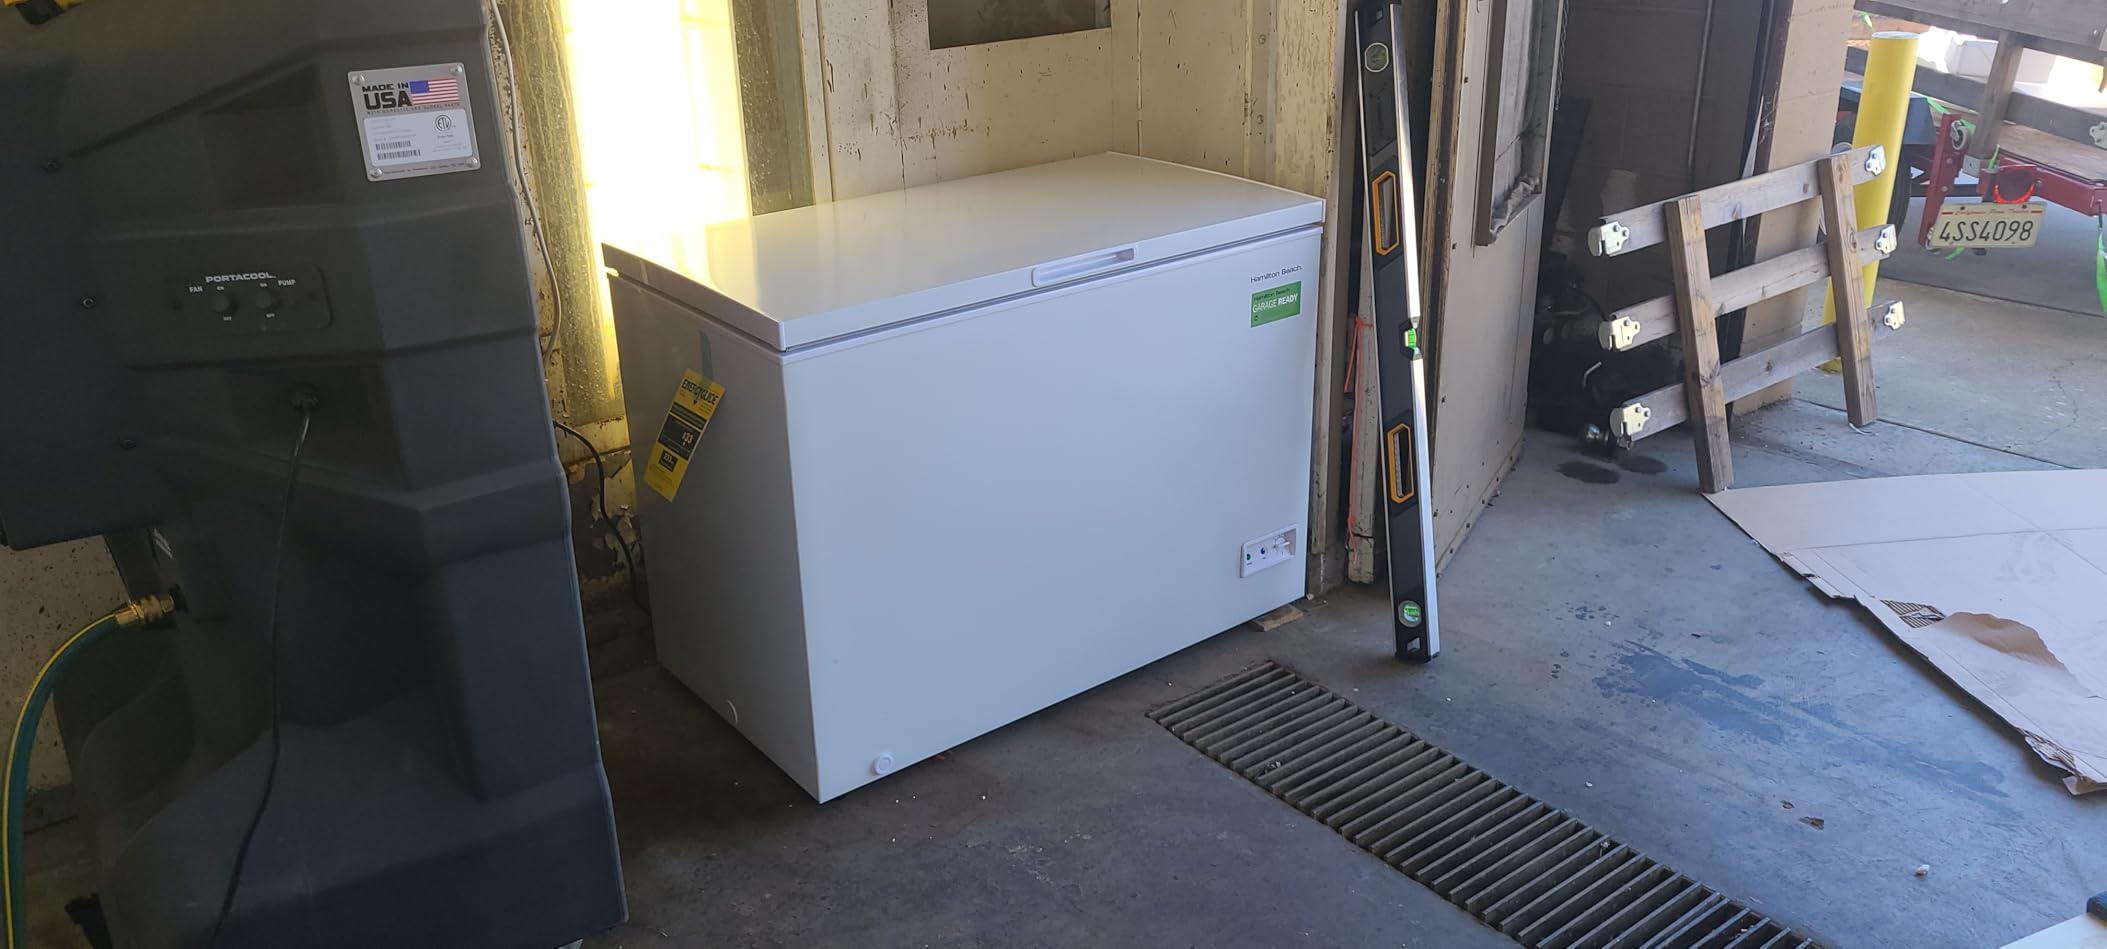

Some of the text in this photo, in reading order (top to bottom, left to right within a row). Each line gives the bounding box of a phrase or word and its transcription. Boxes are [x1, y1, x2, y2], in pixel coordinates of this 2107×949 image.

[362, 81, 409, 93] MADE IN
[363, 90, 413, 110] USA
[1939, 220, 2034, 242] 4SS4098
[205, 272, 273, 283] PORTACOOL
[1250, 265, 1302, 283] Hamilton Beach
[189, 285, 203, 293] FAN
[278, 279, 296, 287] PUMP
[1253, 293, 1298, 312] GARAGE READY
